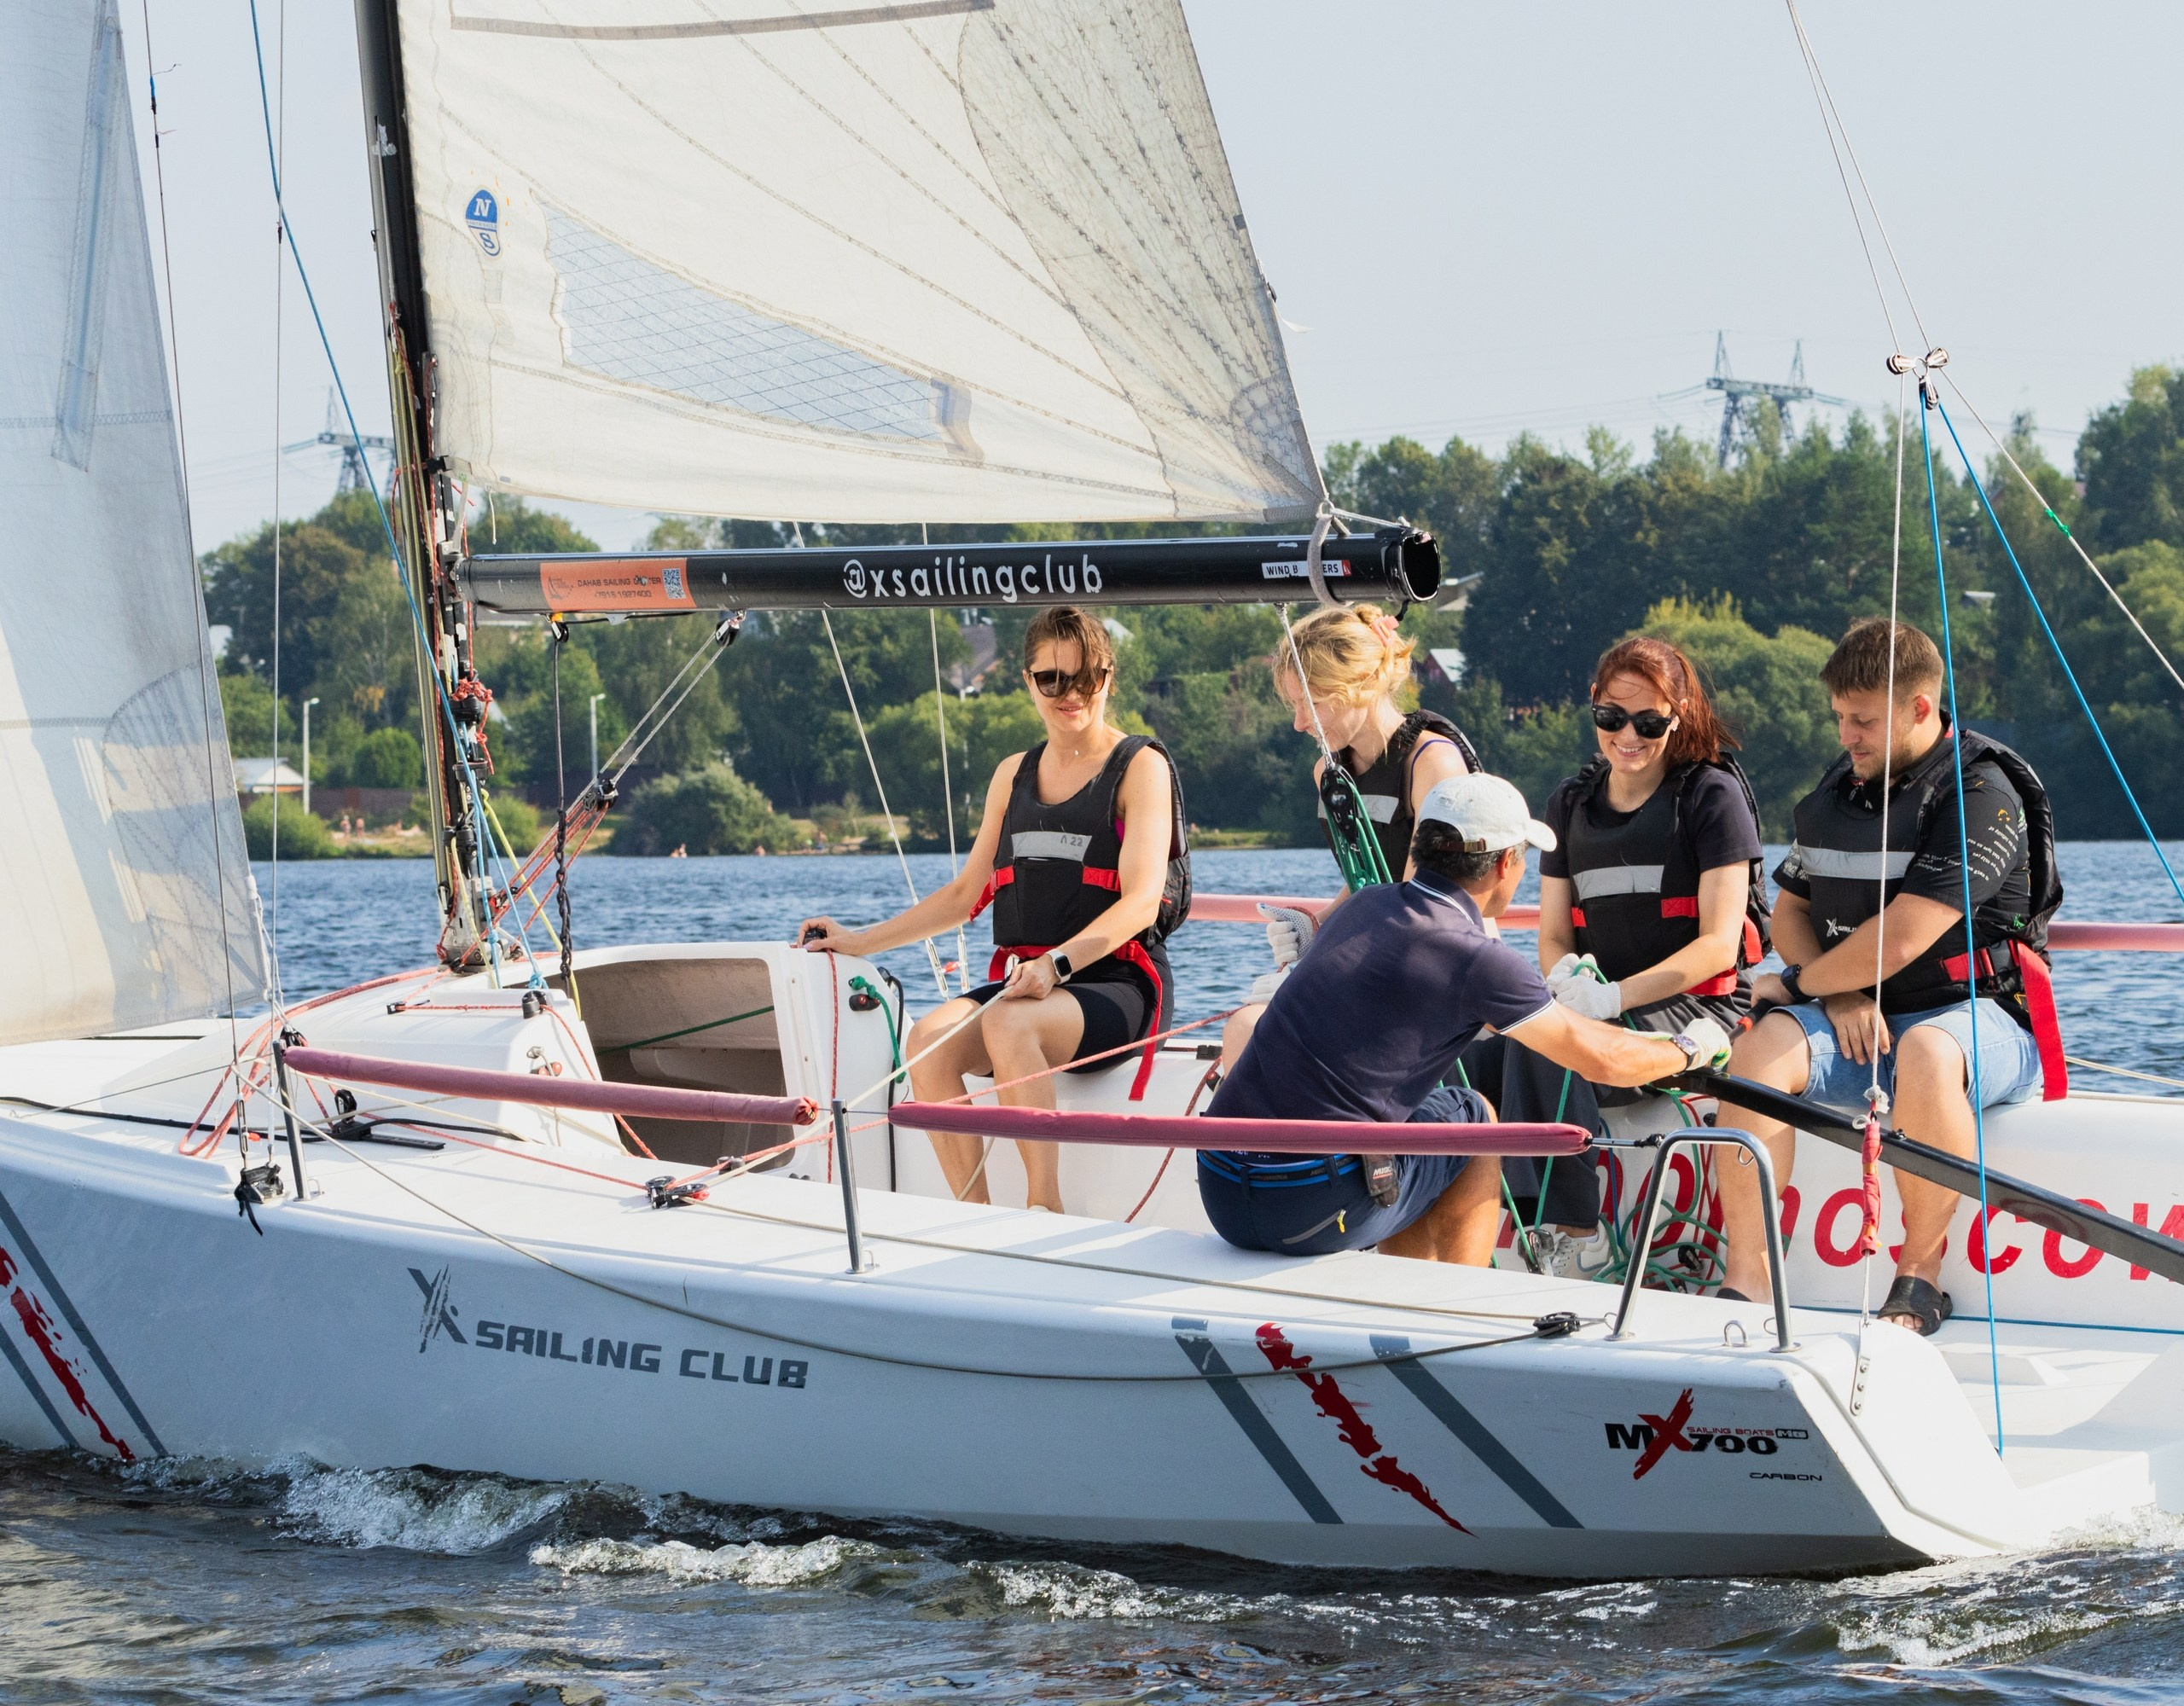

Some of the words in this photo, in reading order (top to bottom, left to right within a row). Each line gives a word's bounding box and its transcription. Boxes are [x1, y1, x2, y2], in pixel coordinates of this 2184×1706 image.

[473, 198, 491, 217] N
[1266, 565, 1290, 576] WIND
[578, 579, 601, 588] DAHAB
[603, 577, 630, 587] SAILING
[843, 554, 1103, 603] @xsailingclub
[1070, 836, 1083, 847] 22
[475, 1320, 662, 1373] SAILING
[679, 1348, 809, 1389] CLUB
[1687, 1426, 1732, 1435] SAILING
[1735, 1428, 1775, 1436] BOATS
[1750, 1471, 1823, 1482] CARBON
